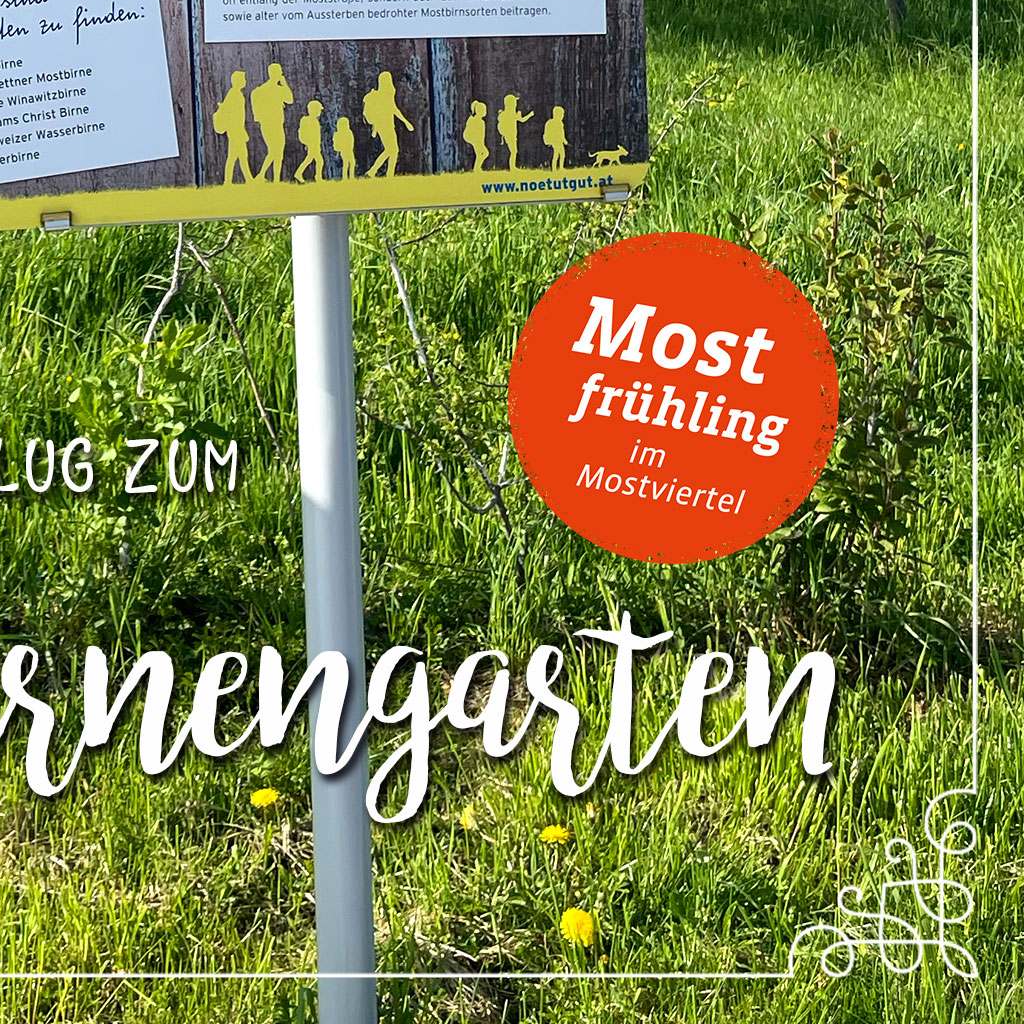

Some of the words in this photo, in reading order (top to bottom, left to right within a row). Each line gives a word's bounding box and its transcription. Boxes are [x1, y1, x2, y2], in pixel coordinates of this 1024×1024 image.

[39, 19, 63, 35] zu
[72, 4, 145, 45] finden:
[36, 68, 92, 84] Mostbirne
[6, 87, 87, 107] Winawitzbirne
[22, 109, 56, 123] Christ
[59, 106, 89, 118] Birne
[35, 122, 105, 140] Wasserbirne
[481, 175, 613, 194] www.noetutgut.at
